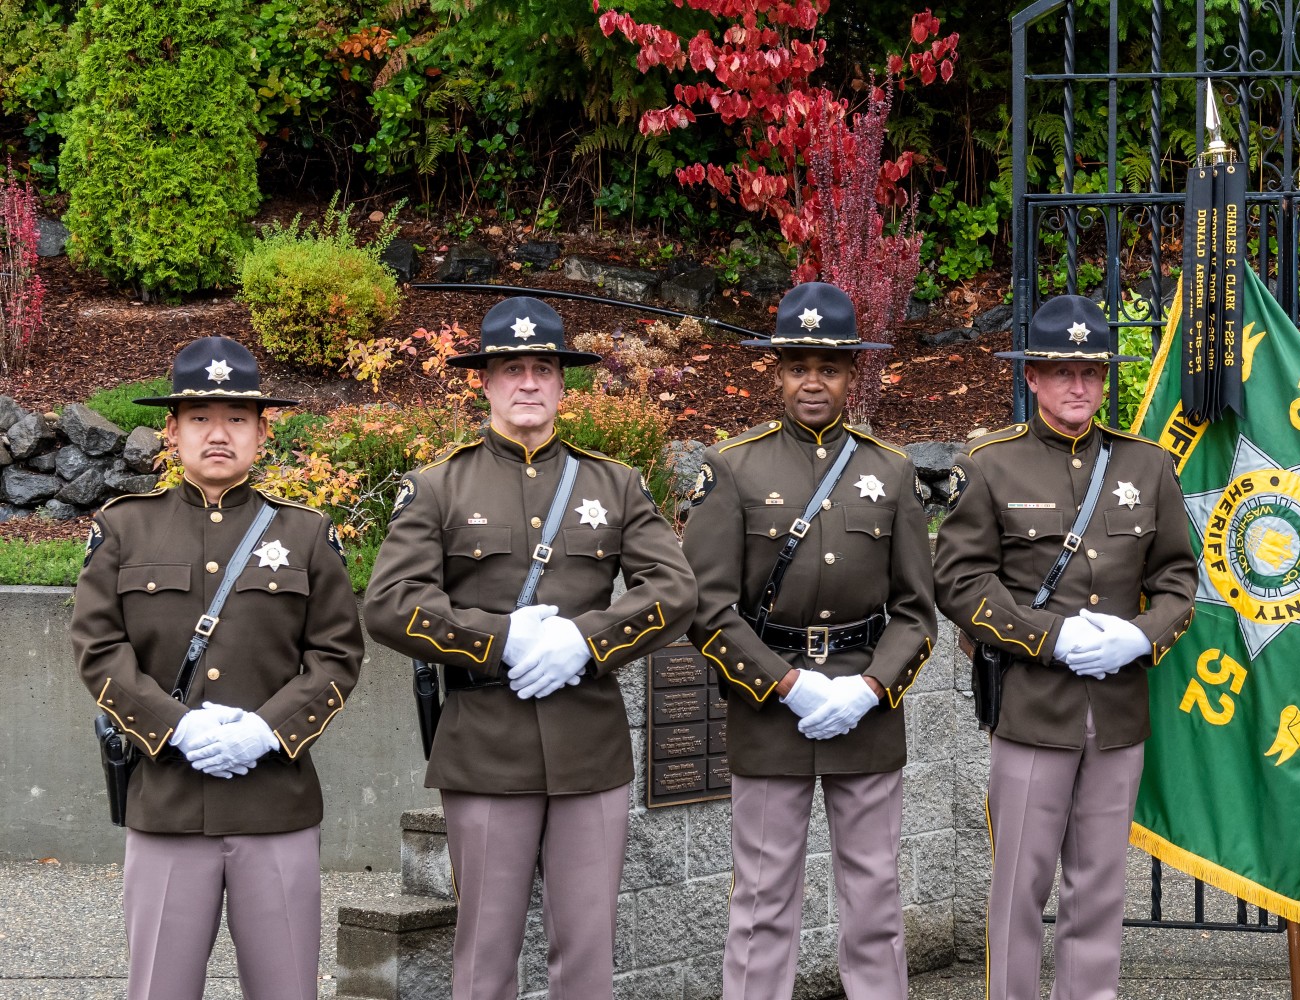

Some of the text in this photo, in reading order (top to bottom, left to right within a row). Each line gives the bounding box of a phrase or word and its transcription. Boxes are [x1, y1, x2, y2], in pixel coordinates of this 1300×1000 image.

[1194, 209, 1207, 373] DONALD ARMENI 9-15-54
[1208, 274, 1217, 303] POOR
[1224, 204, 1237, 367] CHARLES C. CLARK 1-22-36
[1208, 478, 1255, 573] SHERIFF
[1235, 505, 1274, 575] WASHINGTON
[1282, 568, 1299, 586] OF
[1179, 648, 1248, 726] 52
